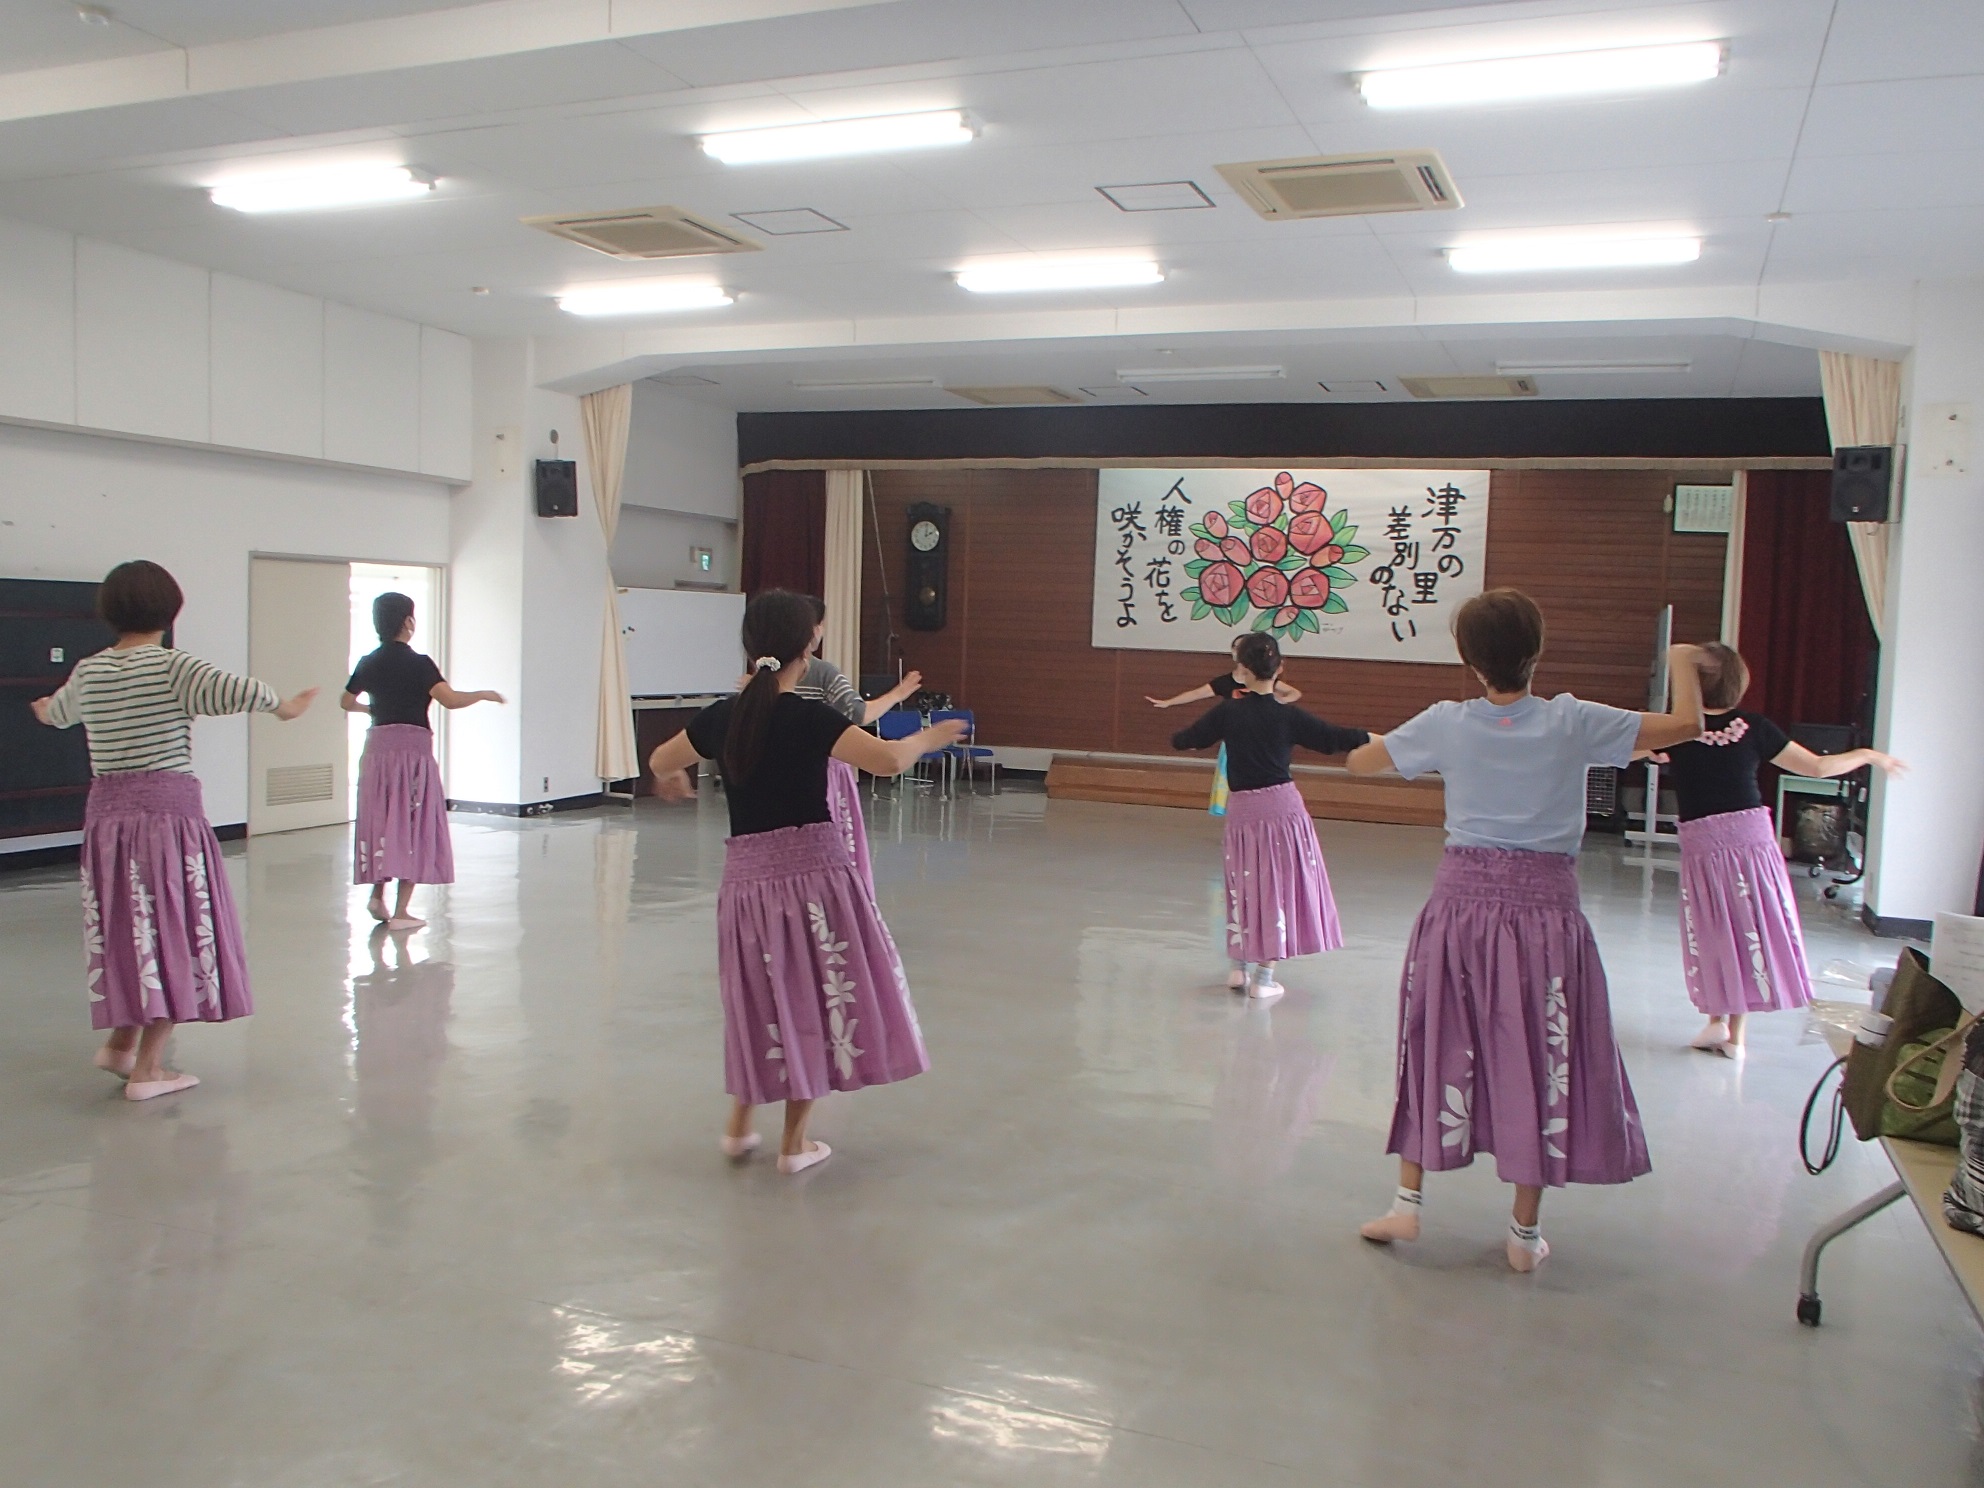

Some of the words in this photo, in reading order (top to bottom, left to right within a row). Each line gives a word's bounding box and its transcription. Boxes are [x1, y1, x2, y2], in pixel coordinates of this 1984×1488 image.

[1111, 501, 1147, 628] 咲かそうよ
[1143, 476, 1192, 622] 人権の花を
[1369, 505, 1420, 642] 差別のない
[1411, 482, 1467, 604] 津万の里
